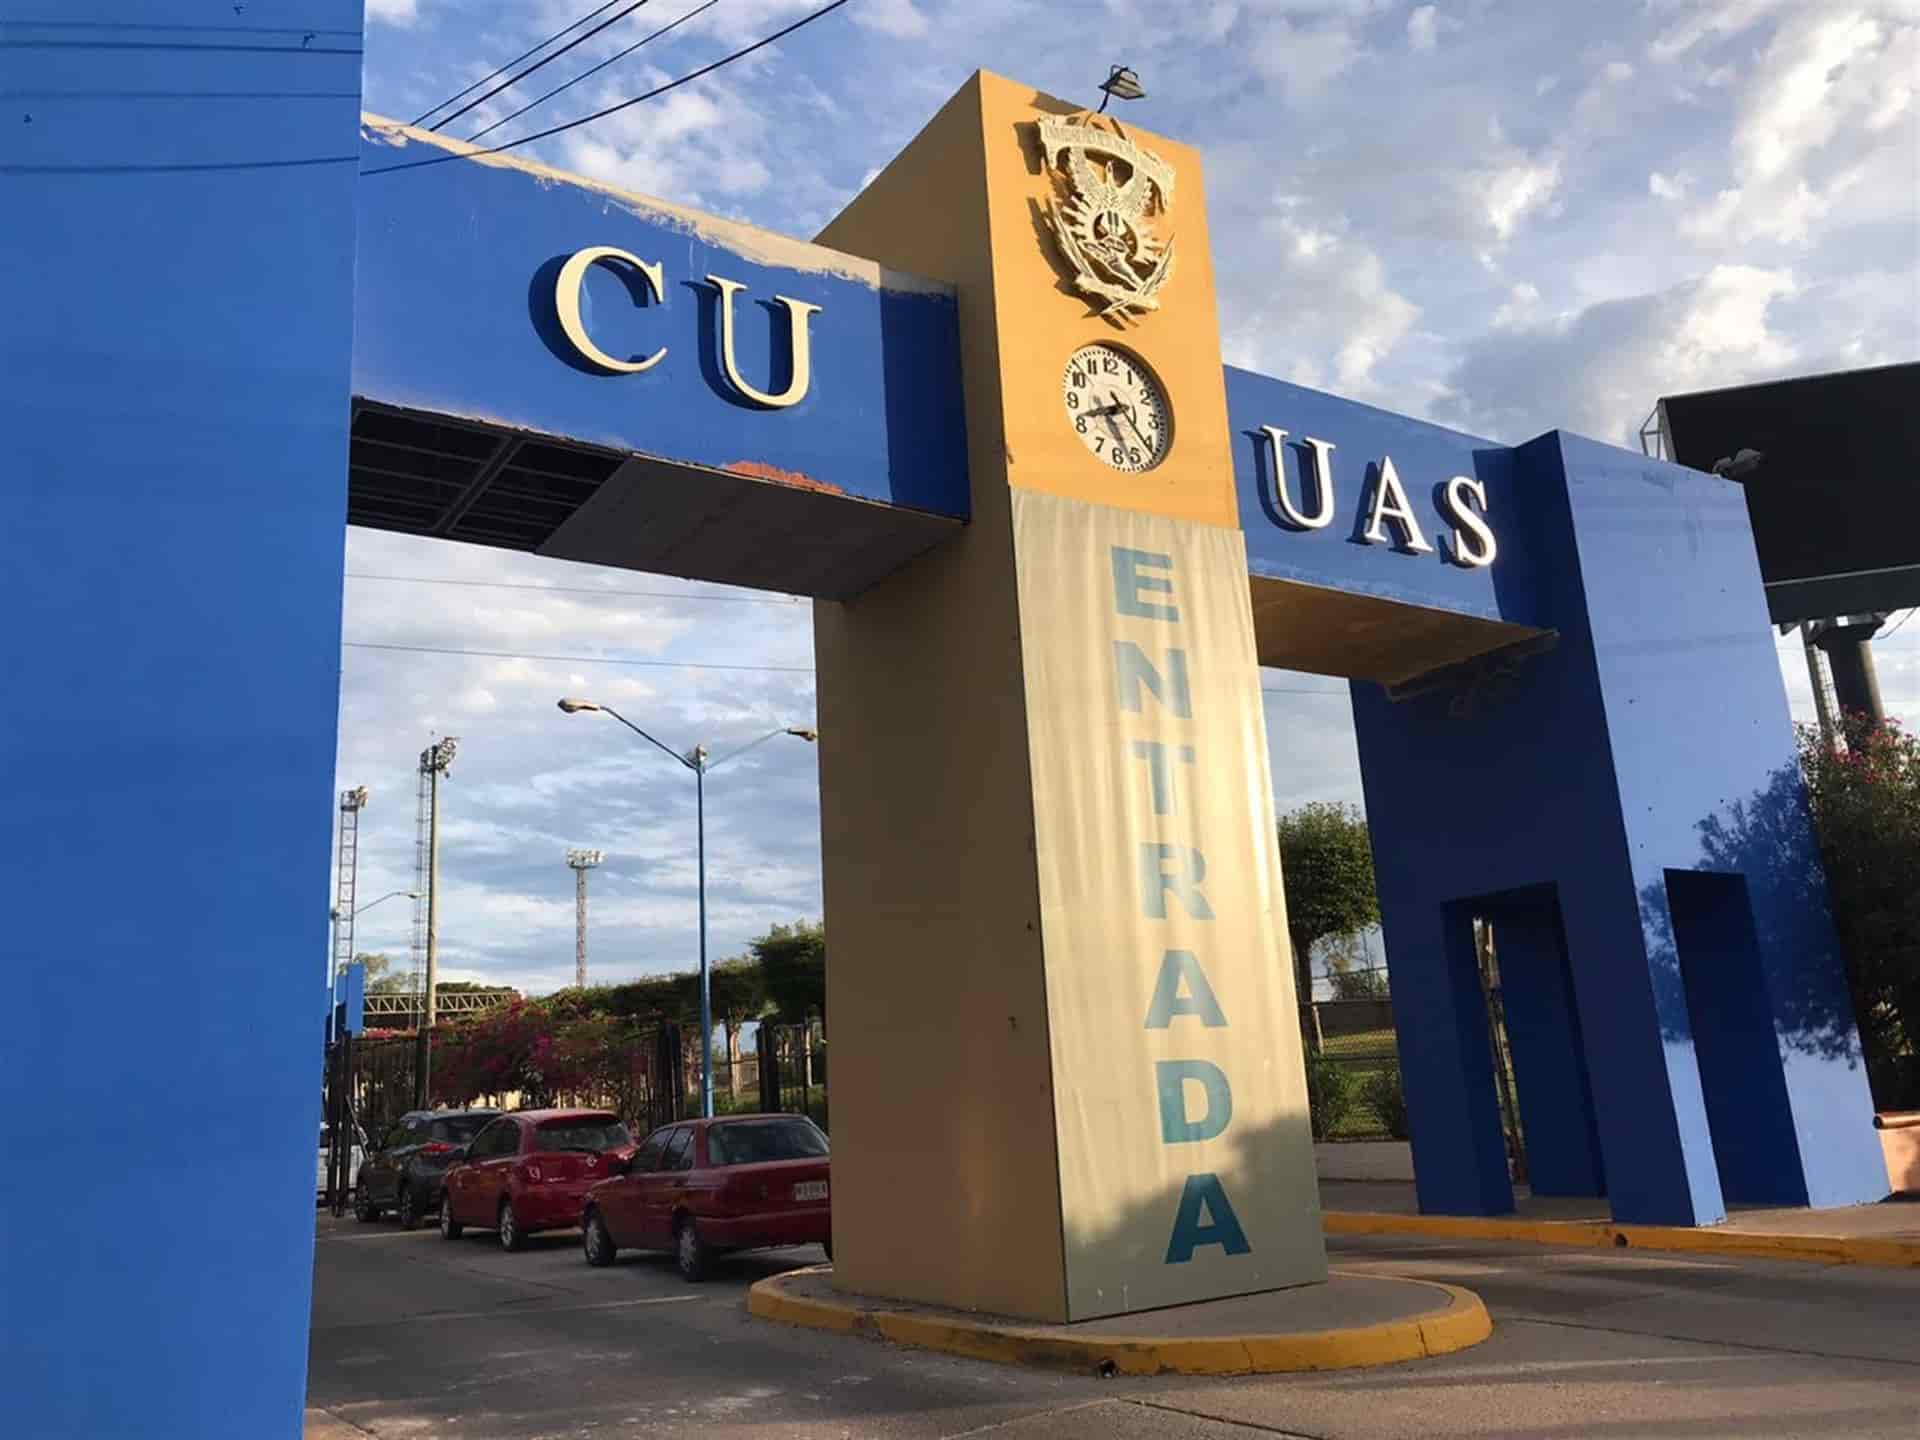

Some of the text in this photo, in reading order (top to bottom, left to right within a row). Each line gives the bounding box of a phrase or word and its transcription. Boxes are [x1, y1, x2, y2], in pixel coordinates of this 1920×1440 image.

[555, 246, 824, 407] CU
[1087, 358, 1098, 376] 11
[1103, 357, 1120, 376] 12
[1072, 370, 1087, 389] 10
[1127, 369, 1133, 386] 1
[1067, 391, 1080, 409] 9
[1140, 388, 1152, 406] 2
[1075, 415, 1088, 434] 8
[1147, 412, 1160, 430] 3
[1095, 436, 1105, 453] 7
[1143, 434, 1153, 454] 4
[1112, 447, 1124, 465] 6
[1129, 446, 1141, 465] 5
[1259, 424, 1498, 567] UAS
[1110, 546, 1252, 1265] ENTRADA
